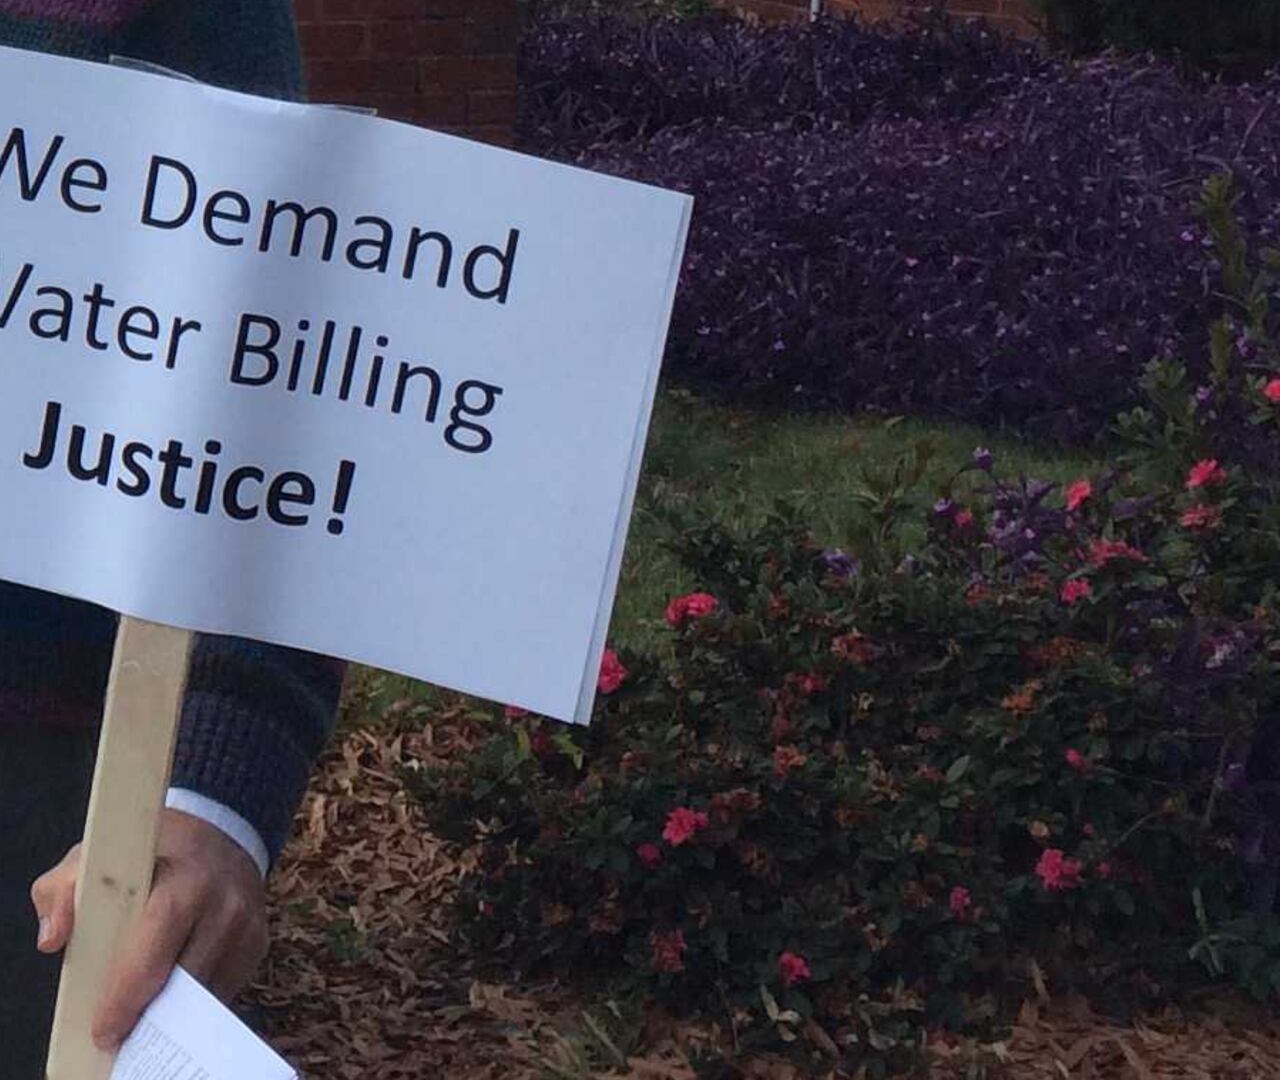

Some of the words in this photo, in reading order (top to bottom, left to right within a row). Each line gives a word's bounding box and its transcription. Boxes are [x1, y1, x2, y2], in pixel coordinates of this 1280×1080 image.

[142, 156, 519, 304] Demand
[230, 314, 502, 453] Billing
[24, 402, 355, 535] Justice!
